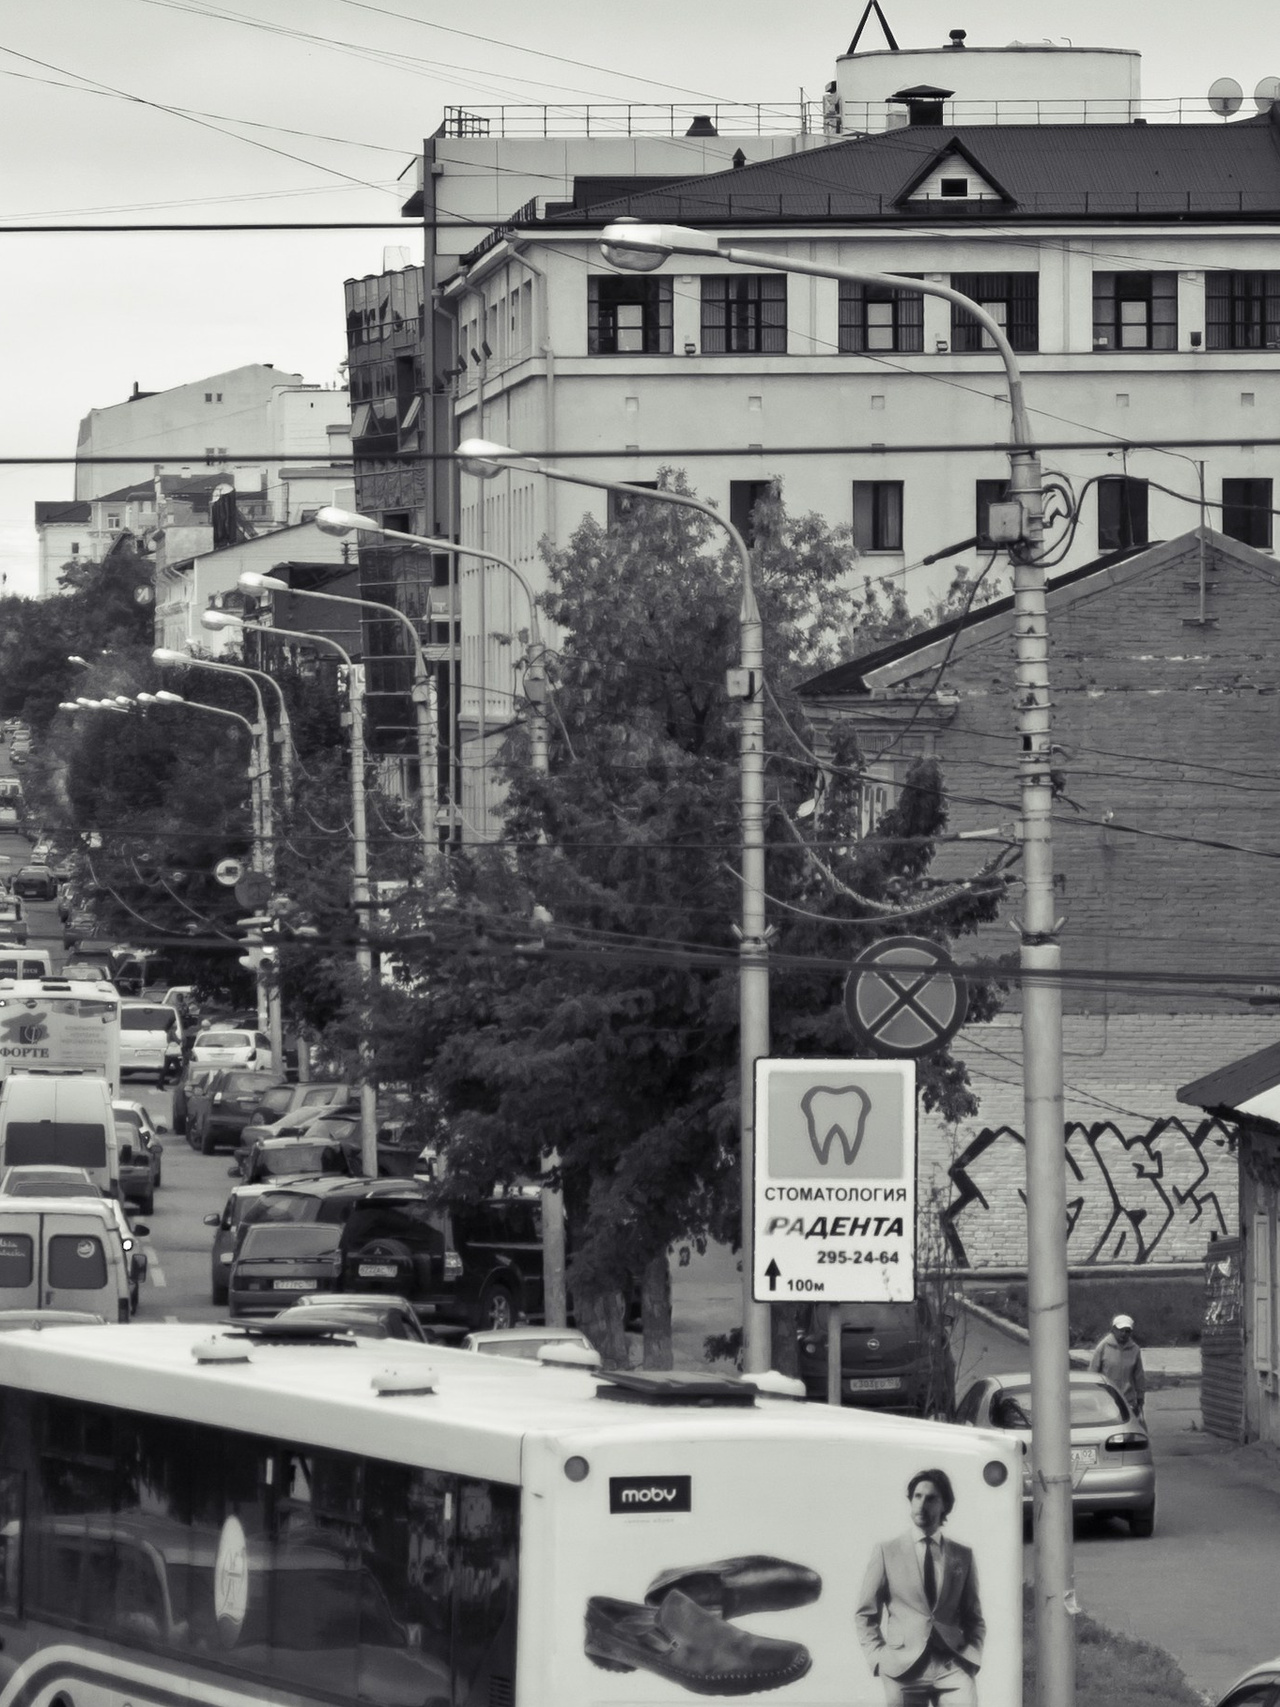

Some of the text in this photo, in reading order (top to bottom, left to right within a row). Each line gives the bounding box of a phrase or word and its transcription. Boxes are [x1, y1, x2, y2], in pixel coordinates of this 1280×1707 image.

[0, 1047, 50, 1059] ФОРТЕ
[764, 1186, 907, 1202] СТОМАТОЛОГИЯ
[765, 1216, 904, 1240] РАДЕНТА
[817, 1250, 900, 1265] 295-24-64
[622, 1486, 677, 1503] moby
